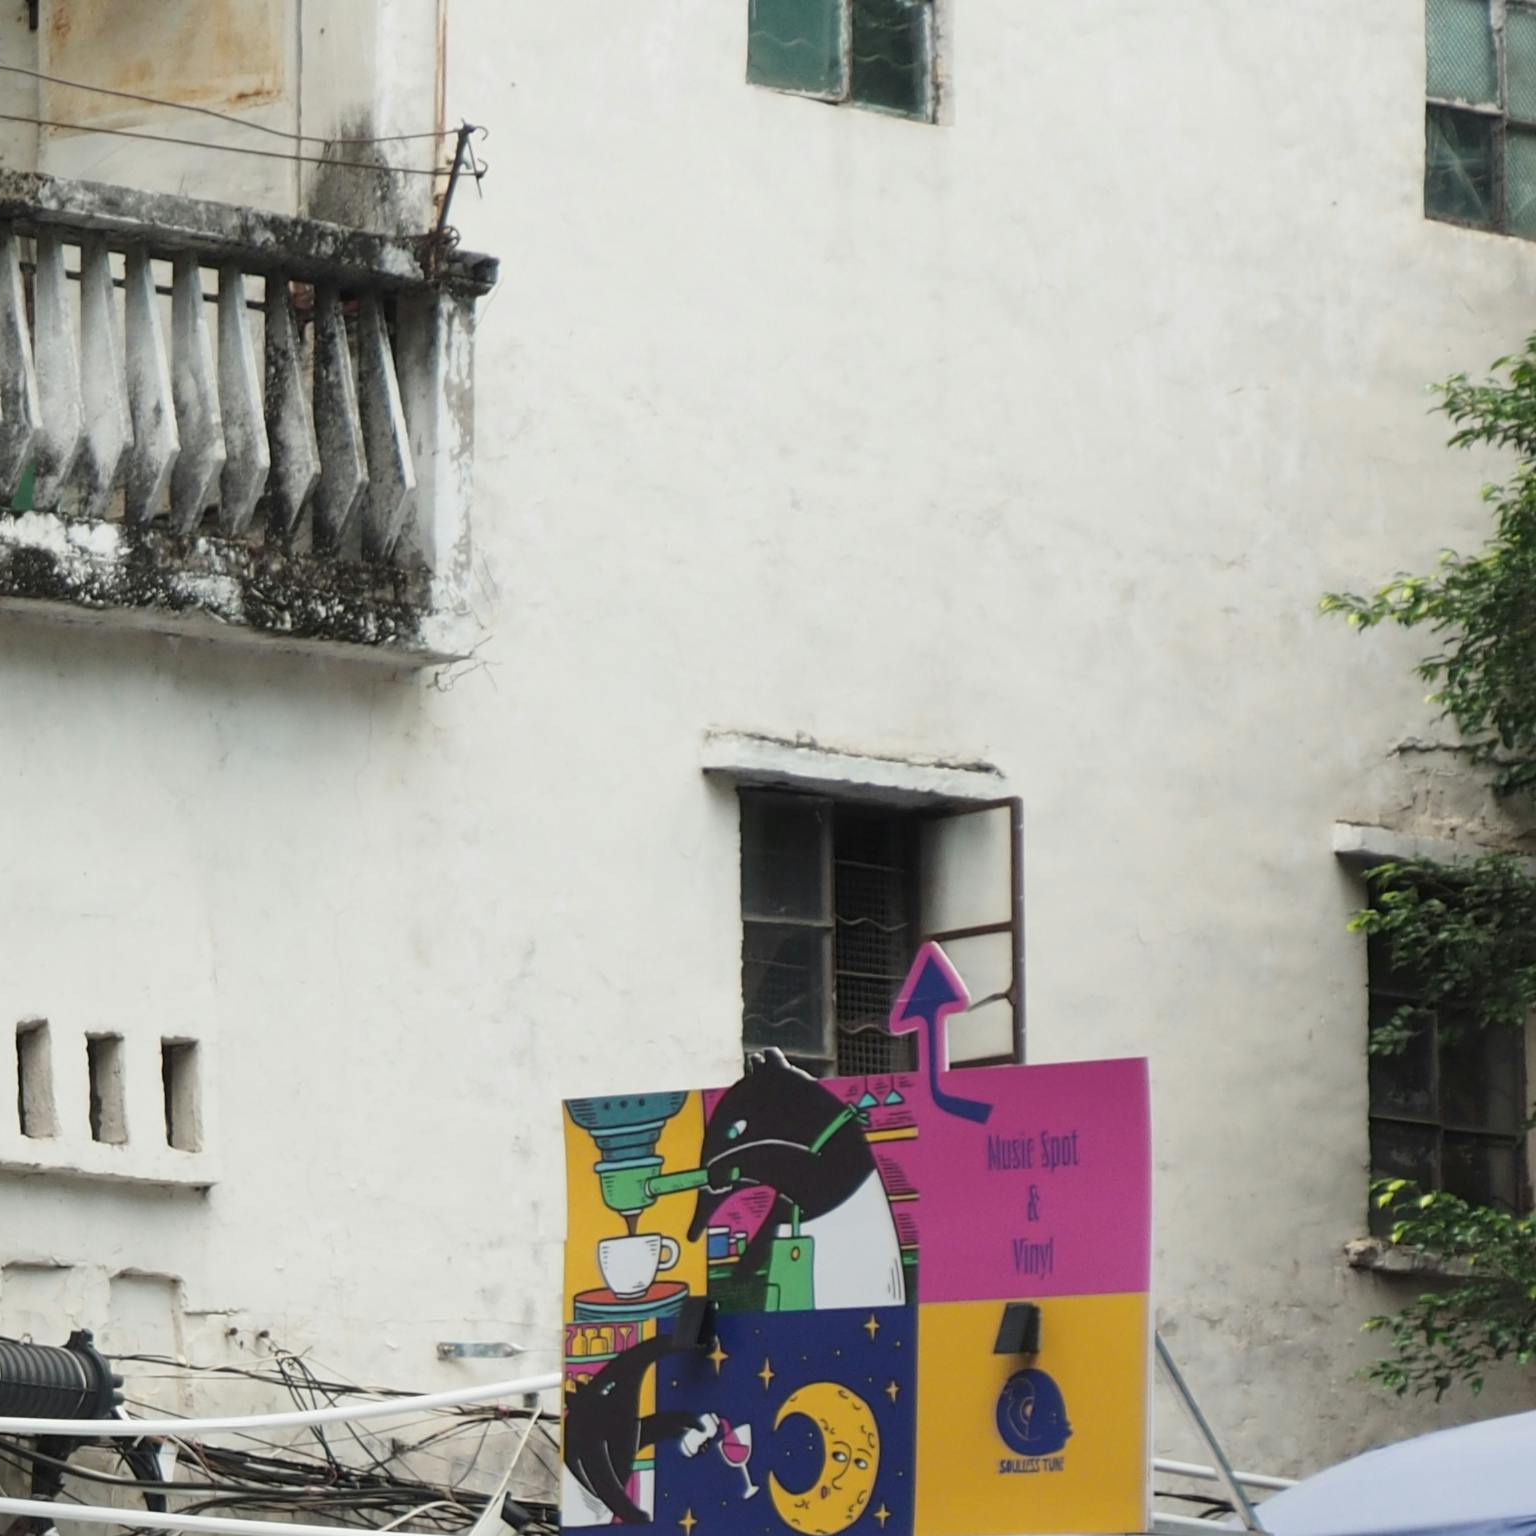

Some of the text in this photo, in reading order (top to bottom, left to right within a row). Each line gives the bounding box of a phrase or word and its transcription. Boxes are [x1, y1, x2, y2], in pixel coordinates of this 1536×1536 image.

[988, 1129, 1079, 1172] Music Spot
[1027, 1184, 1040, 1222] &
[1013, 1237, 1054, 1280] Vinyl
